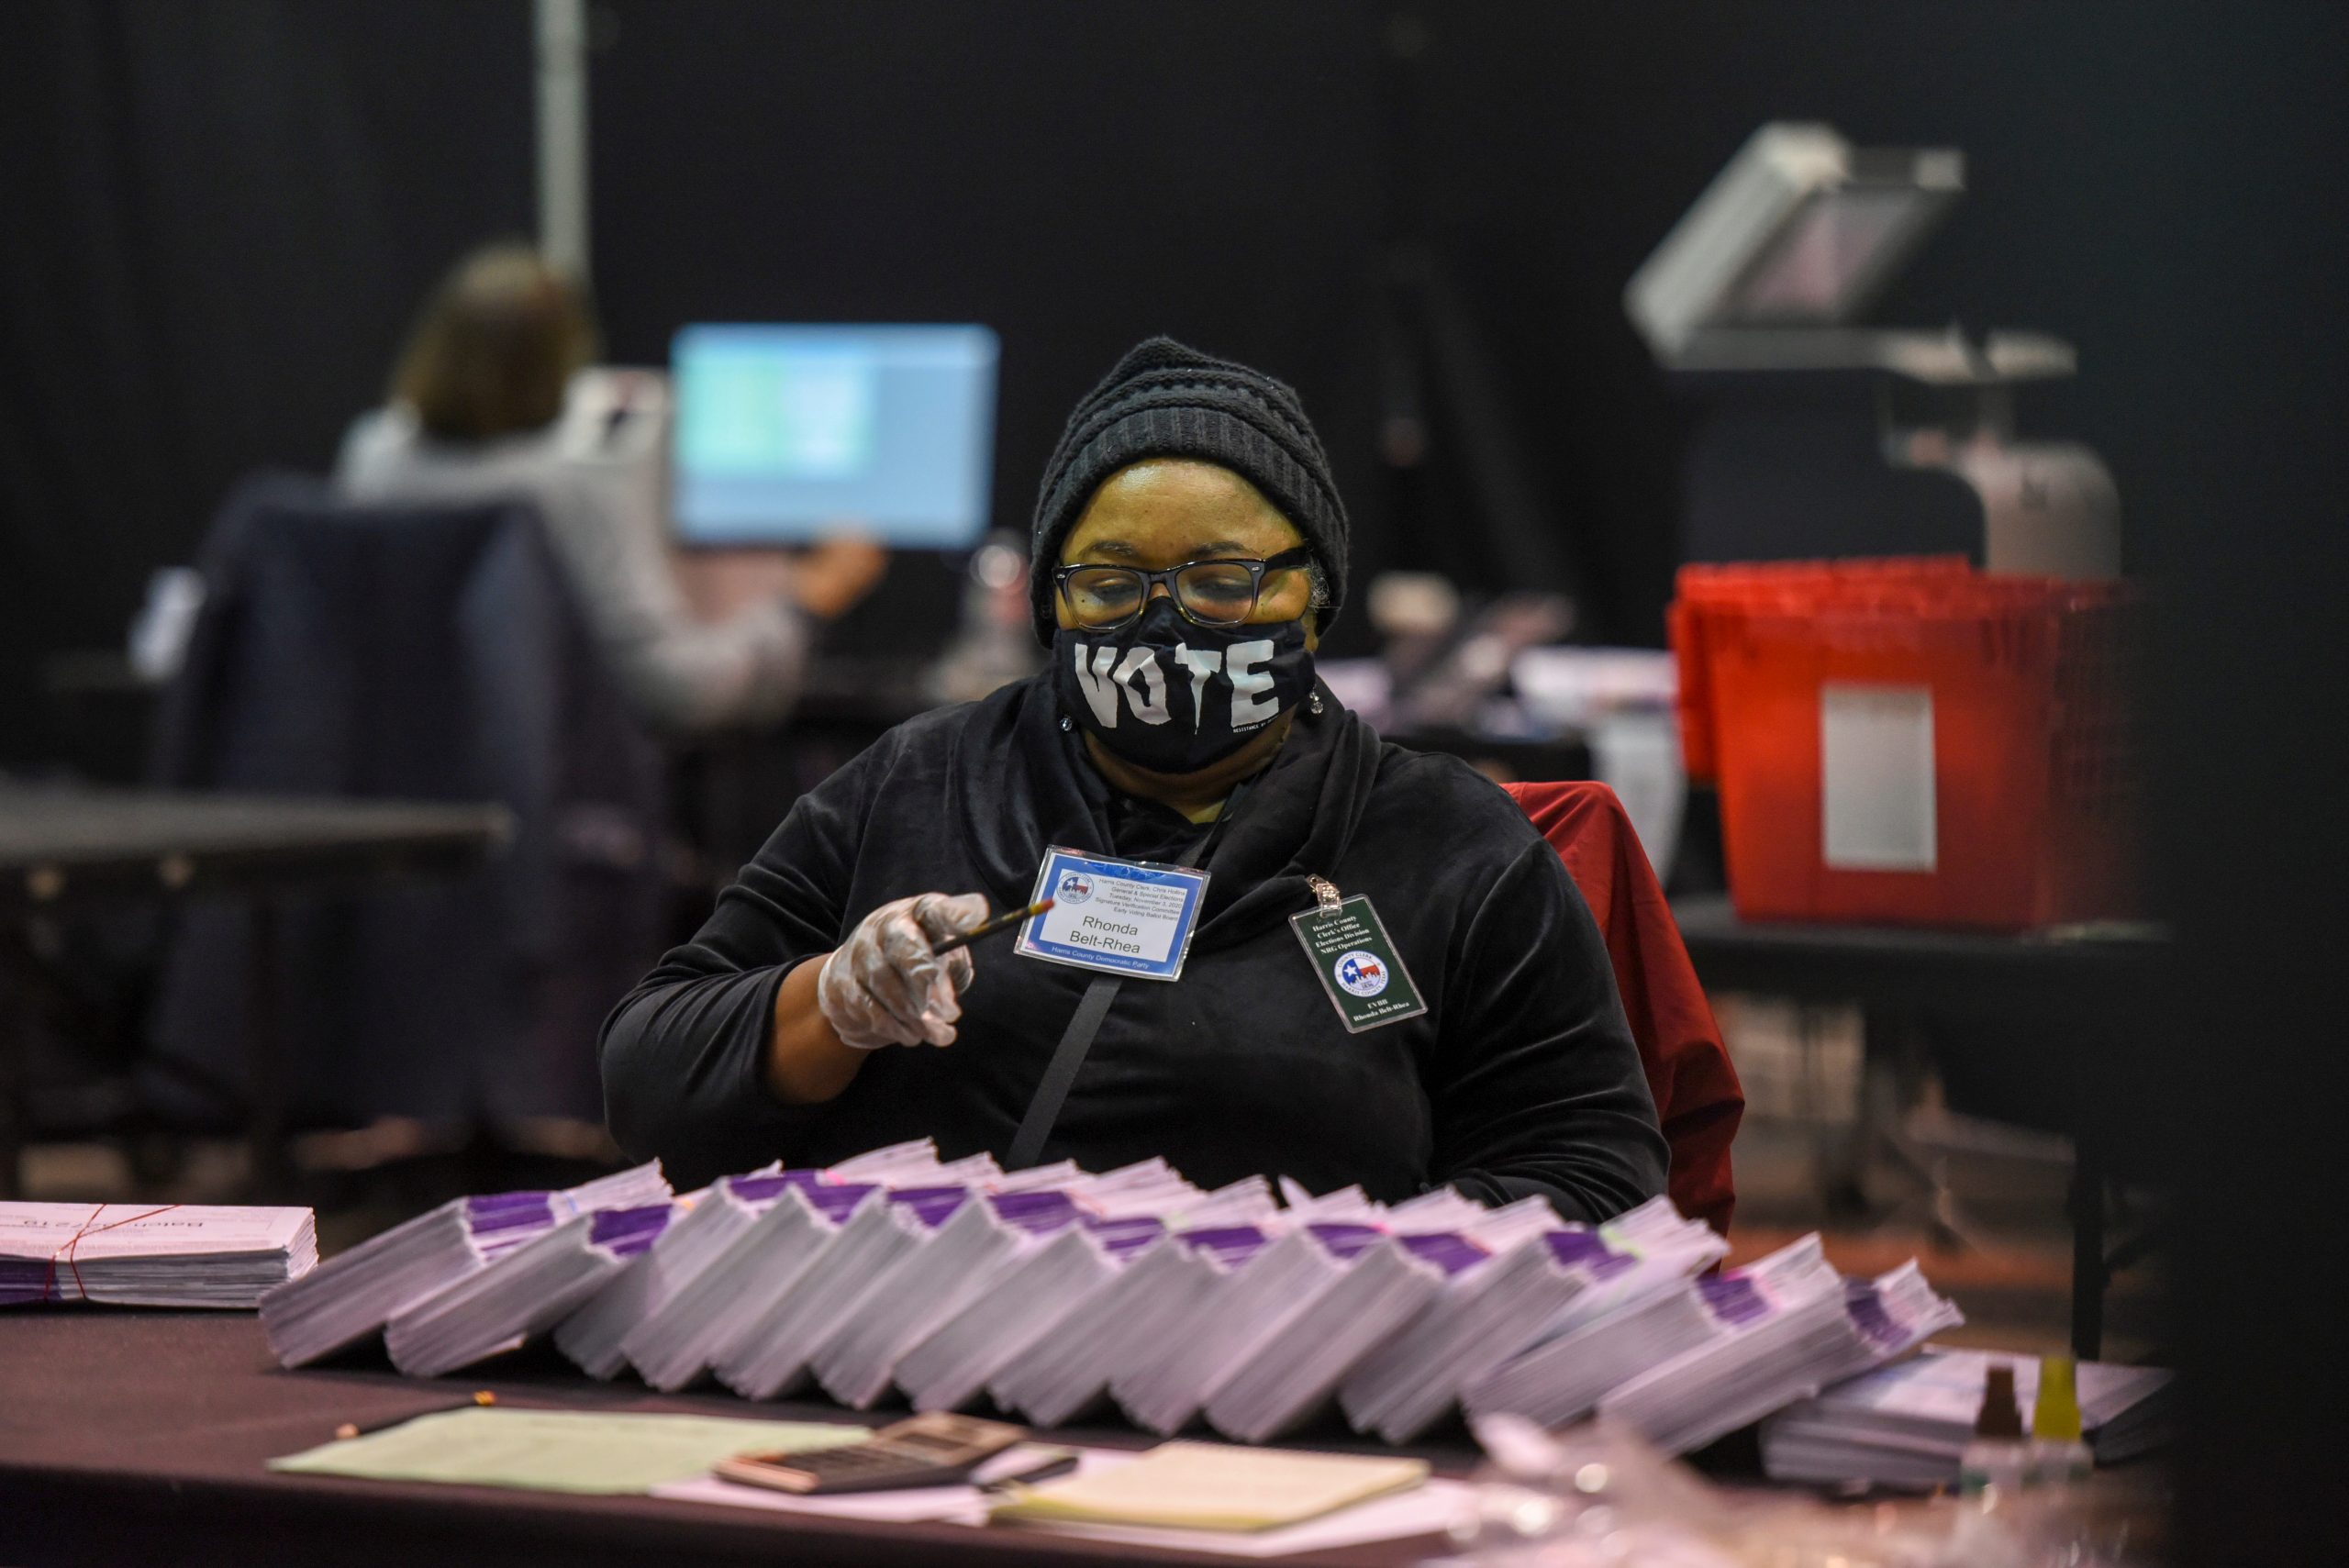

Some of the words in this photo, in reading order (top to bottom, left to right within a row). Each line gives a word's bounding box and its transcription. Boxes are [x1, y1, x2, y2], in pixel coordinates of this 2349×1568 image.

[1074, 639, 1279, 735] VOTE
[1111, 886, 1133, 895] General
[1140, 890, 1159, 899] Special
[1116, 881, 1135, 889] County
[1133, 896, 1161, 906] November
[1113, 906, 1127, 915] Early
[1082, 916, 1139, 936] Rhonda
[1312, 922, 1334, 932] Harris
[1333, 916, 1357, 926] County
[1317, 928, 1341, 939] Clerk's
[1341, 923, 1360, 932] Office
[1069, 930, 1141, 954] Belt-Rhea
[1315, 936, 1344, 948] Elections
[1343, 929, 1370, 940] Division
[1320, 946, 1338, 954] NRG
[1337, 937, 1373, 950] Operations
[1052, 946, 1071, 955] Harris
[1072, 949, 1095, 962] County
[1095, 954, 1130, 966] Democratic
[1131, 960, 1150, 970] Party
[1338, 953, 1354, 968] COUNTY
[1353, 1010, 1378, 1021] Rhonda
[1378, 1002, 1409, 1015] Belt-Rhea
[1367, 999, 1388, 1008] EVBB
